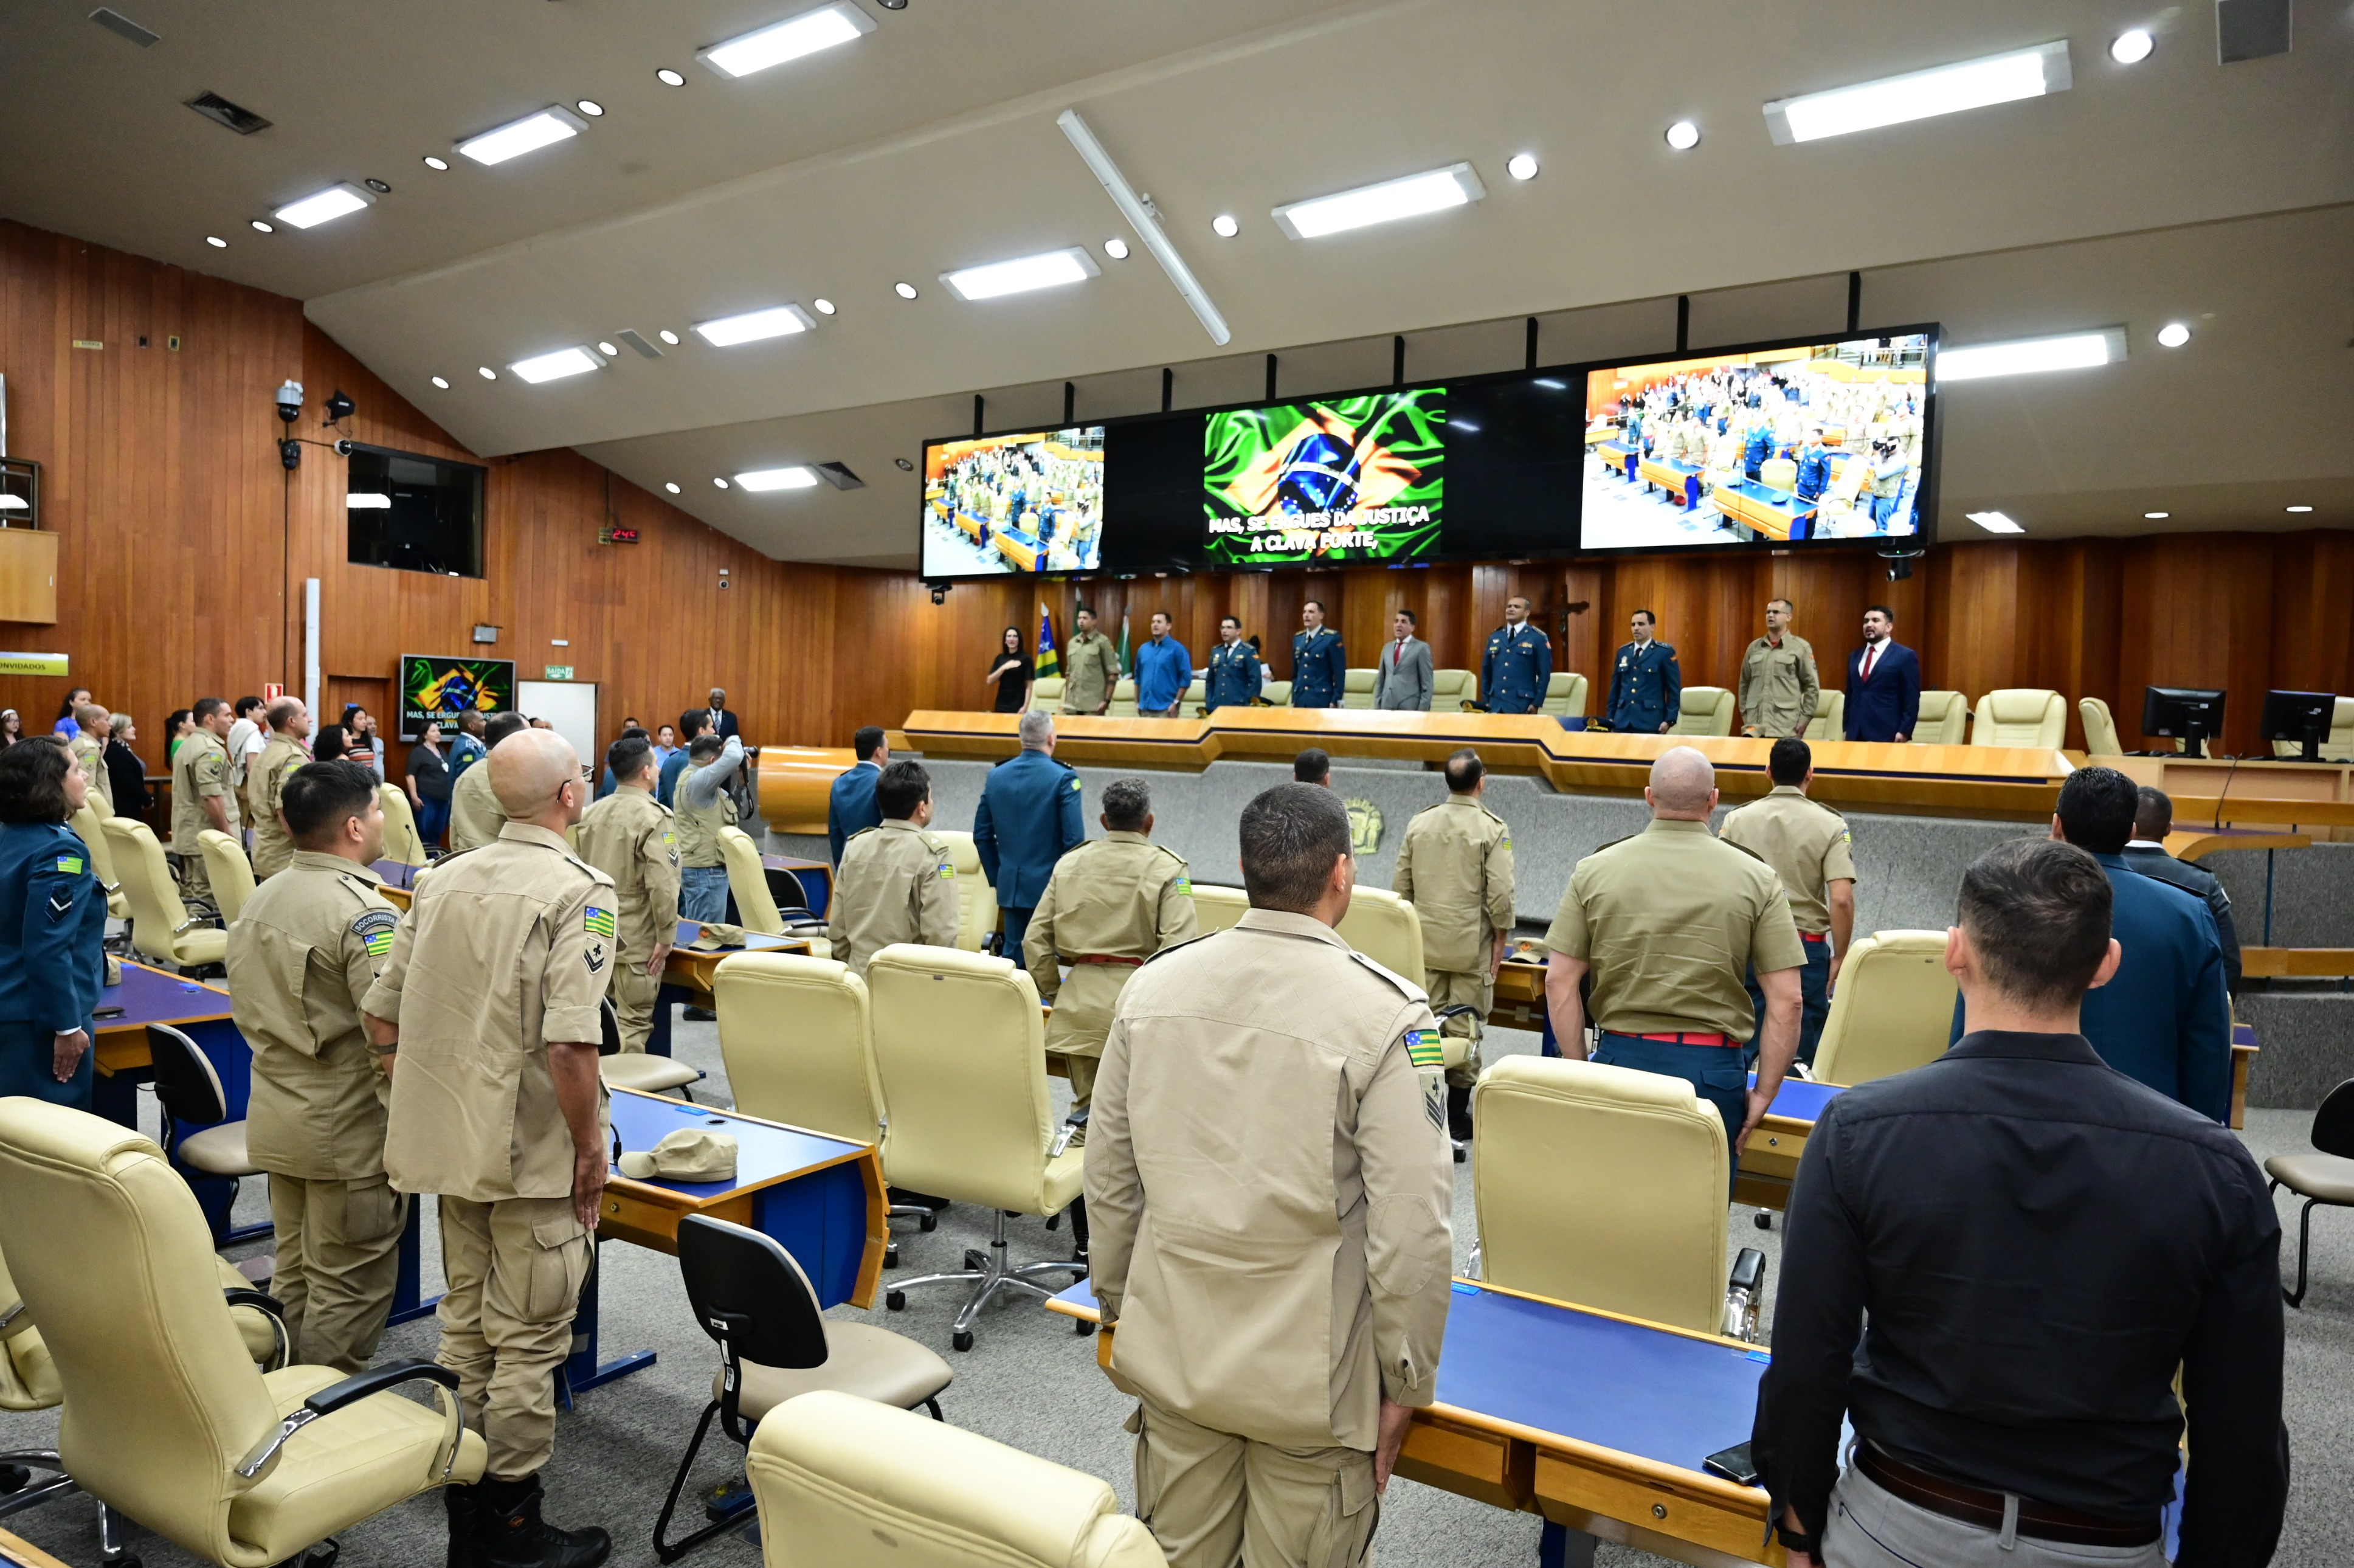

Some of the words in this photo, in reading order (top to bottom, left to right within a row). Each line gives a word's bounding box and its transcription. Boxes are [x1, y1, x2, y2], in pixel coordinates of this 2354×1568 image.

[1209, 517, 1244, 534] MAS,
[1247, 516, 1266, 531] SE
[1269, 512, 1331, 530] ERGUES
[1334, 510, 1357, 527] DA
[1359, 506, 1429, 526] JUSTIÇA
[1250, 536, 1263, 552] A
[1265, 533, 1316, 551] CLAVA
[1320, 531, 1378, 550] FORTE,
[407, 711, 424, 720] MAS,
[355, 914, 395, 931] SOCORRISTA
